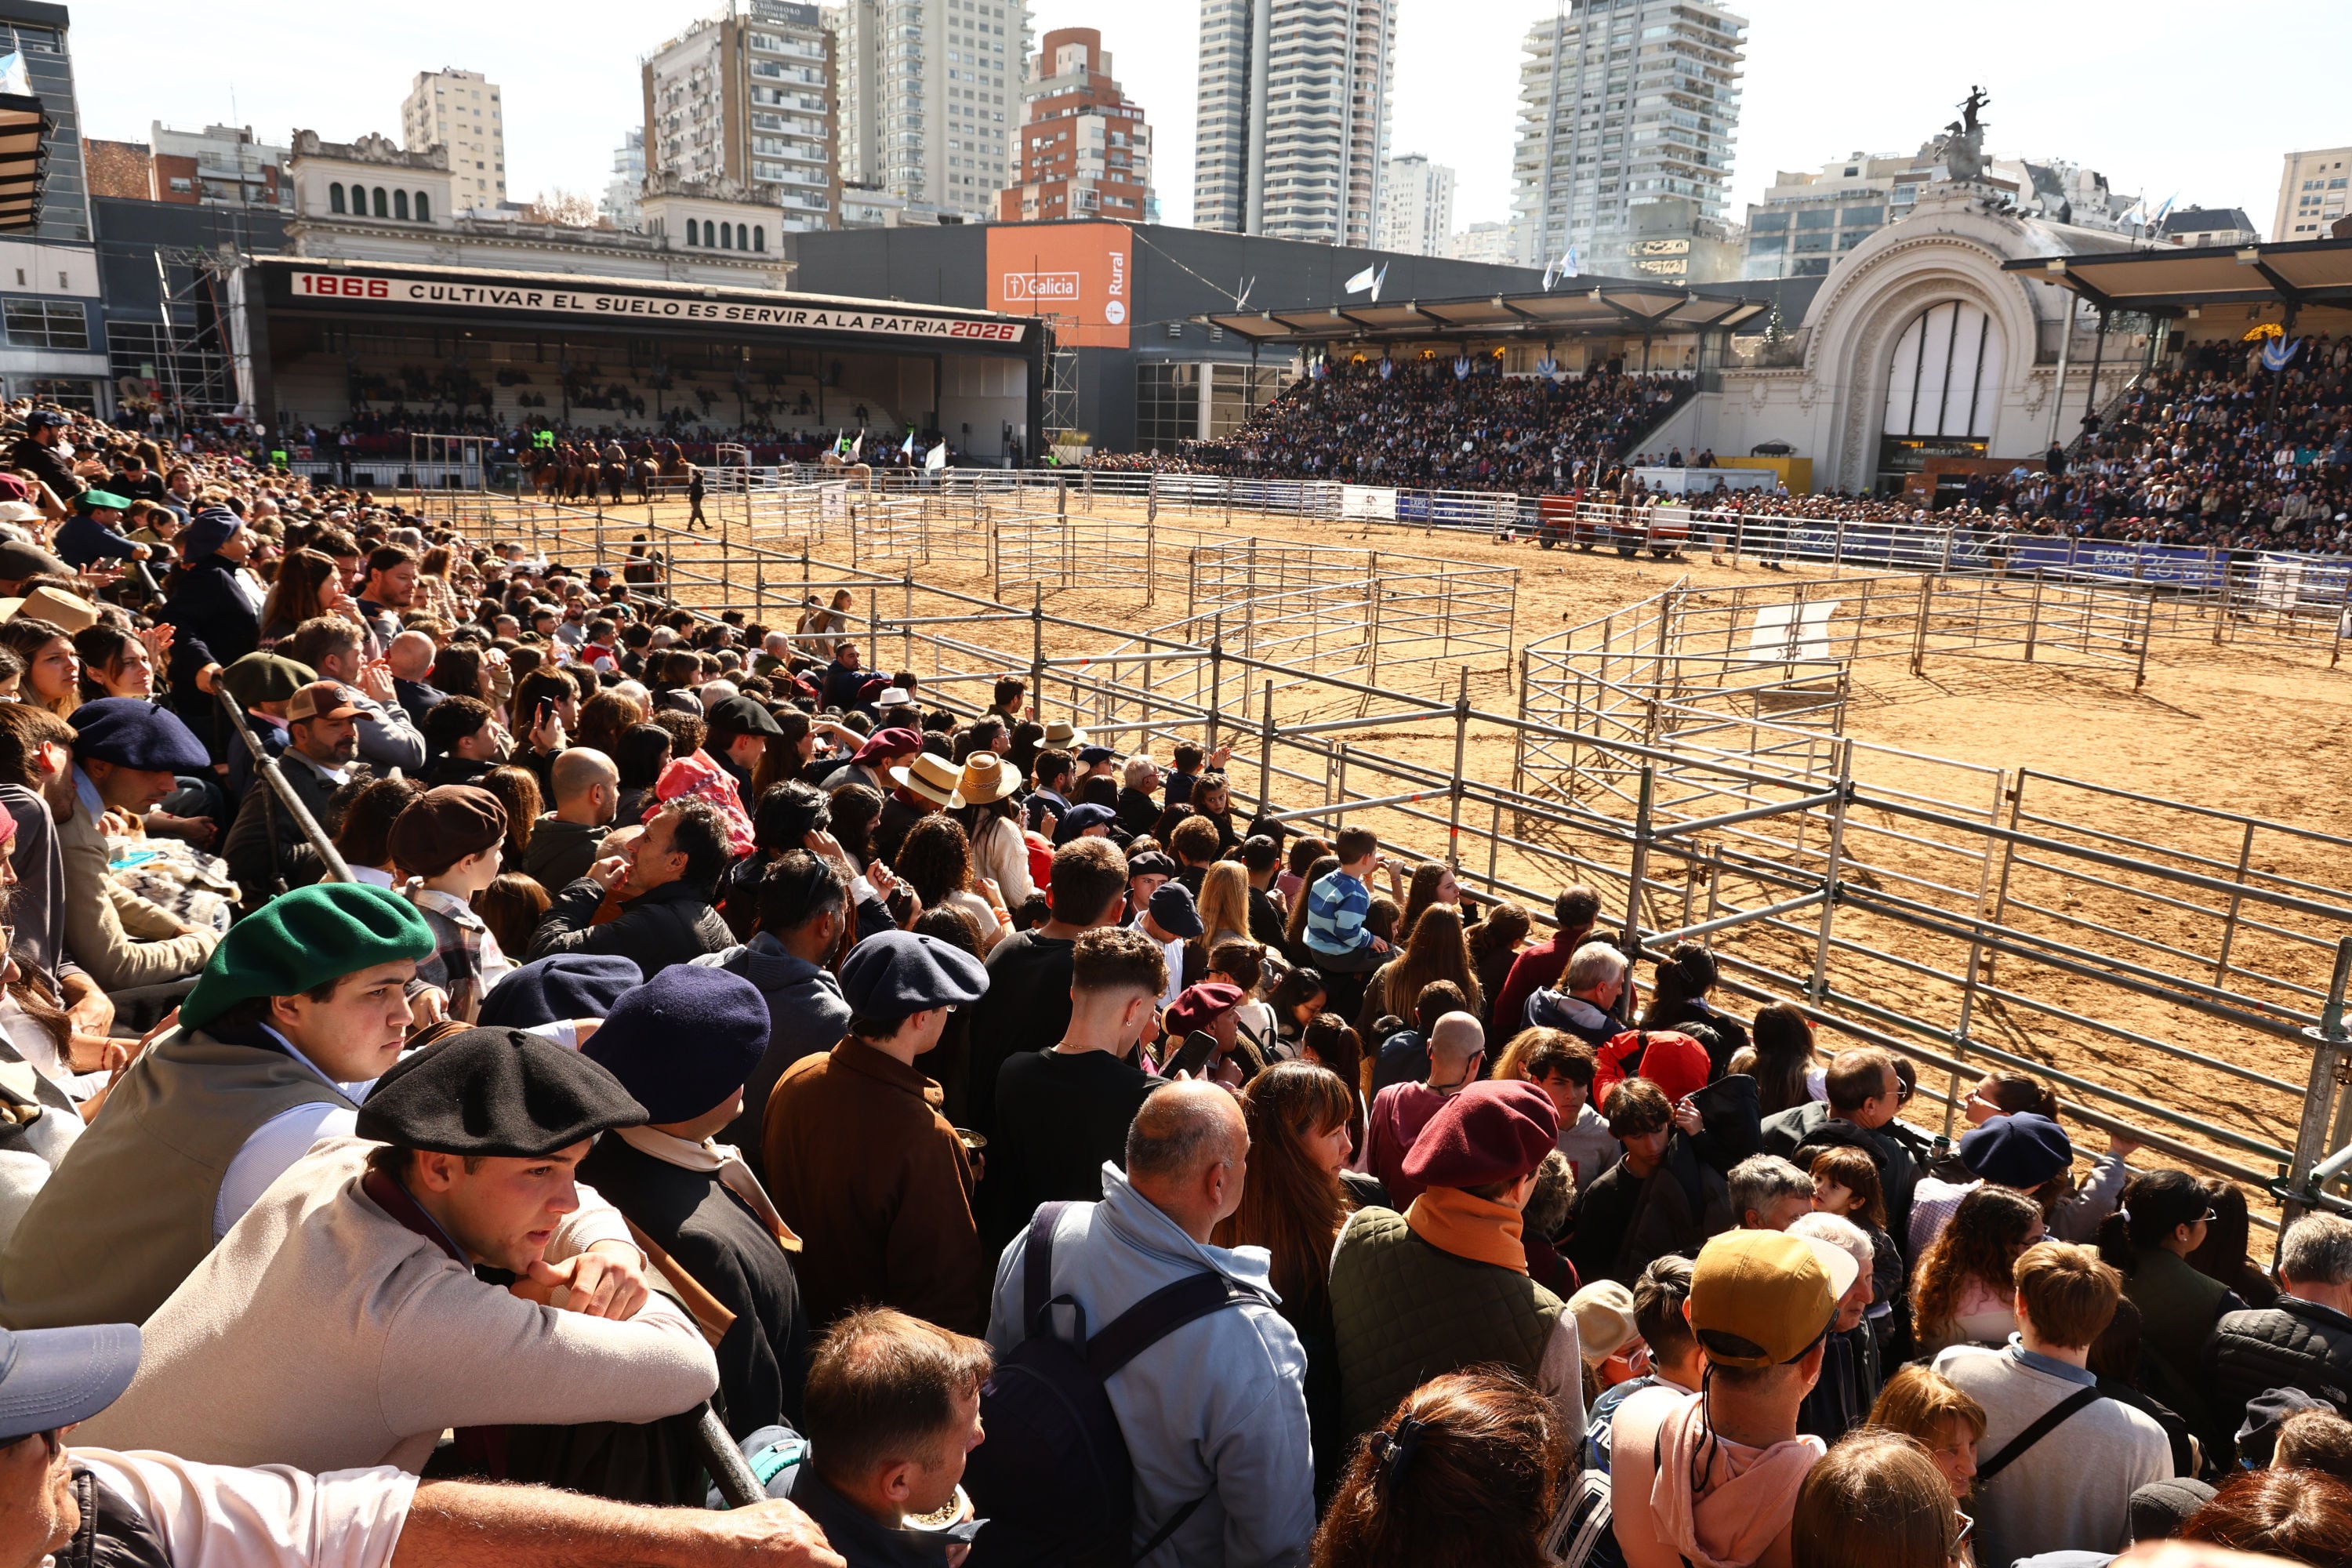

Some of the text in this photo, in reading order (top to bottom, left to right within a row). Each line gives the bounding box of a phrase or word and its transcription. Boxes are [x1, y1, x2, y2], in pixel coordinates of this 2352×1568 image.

[1028, 277, 1073, 295] Galicia
[1109, 252, 1123, 296] Rural
[303, 275, 1015, 340] 1866 CULTIVAR EL SUELO ES SERVIR A LA PATRIA 2026
[2094, 550, 2137, 564] EXPO
